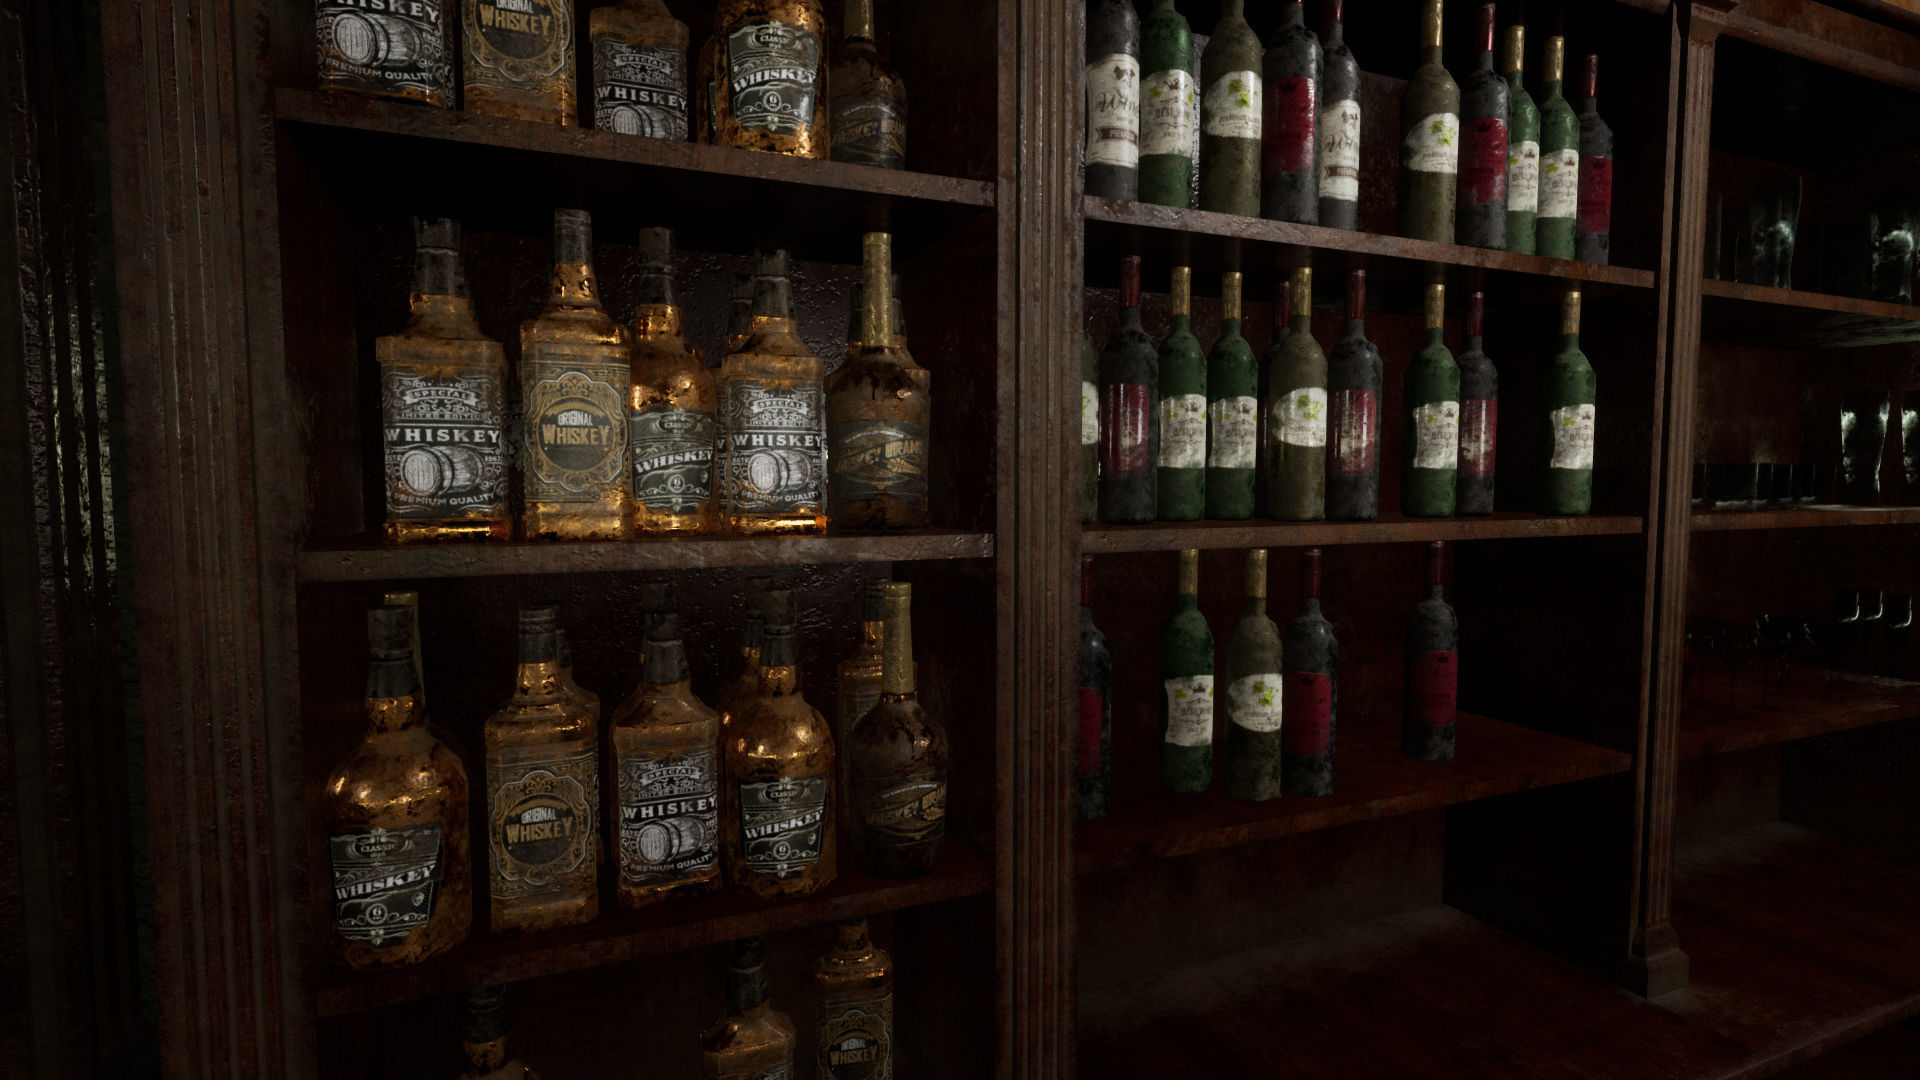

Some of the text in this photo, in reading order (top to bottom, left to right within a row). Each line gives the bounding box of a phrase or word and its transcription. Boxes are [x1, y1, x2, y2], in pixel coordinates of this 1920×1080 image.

[480, 3, 552, 36] WHISKEY
[326, 58, 433, 81] PREMIUM QUALITY
[733, 68, 817, 93] WHISKEY
[597, 86, 687, 110] WHISKEY
[414, 389, 469, 399] SPECIAL
[557, 410, 593, 426] ORIGINAL
[385, 428, 500, 443] WHISKEY
[541, 424, 609, 445] WHISKEY
[734, 434, 822, 447] WHISKEY
[635, 450, 714, 473] WHISKEY
[394, 491, 495, 505] PREMIUM QUALITY
[742, 489, 819, 502] PREMIUM QUALITY
[521, 806, 557, 824] ORIGINAL
[622, 796, 717, 819] WHISKEY
[506, 816, 574, 845] WHISKEY
[745, 810, 824, 839] WHISKEY
[630, 853, 713, 872] PREMIUM QUALITY
[336, 864, 436, 900] WHISKEY
[830, 1045, 879, 1065] WHISKEY
